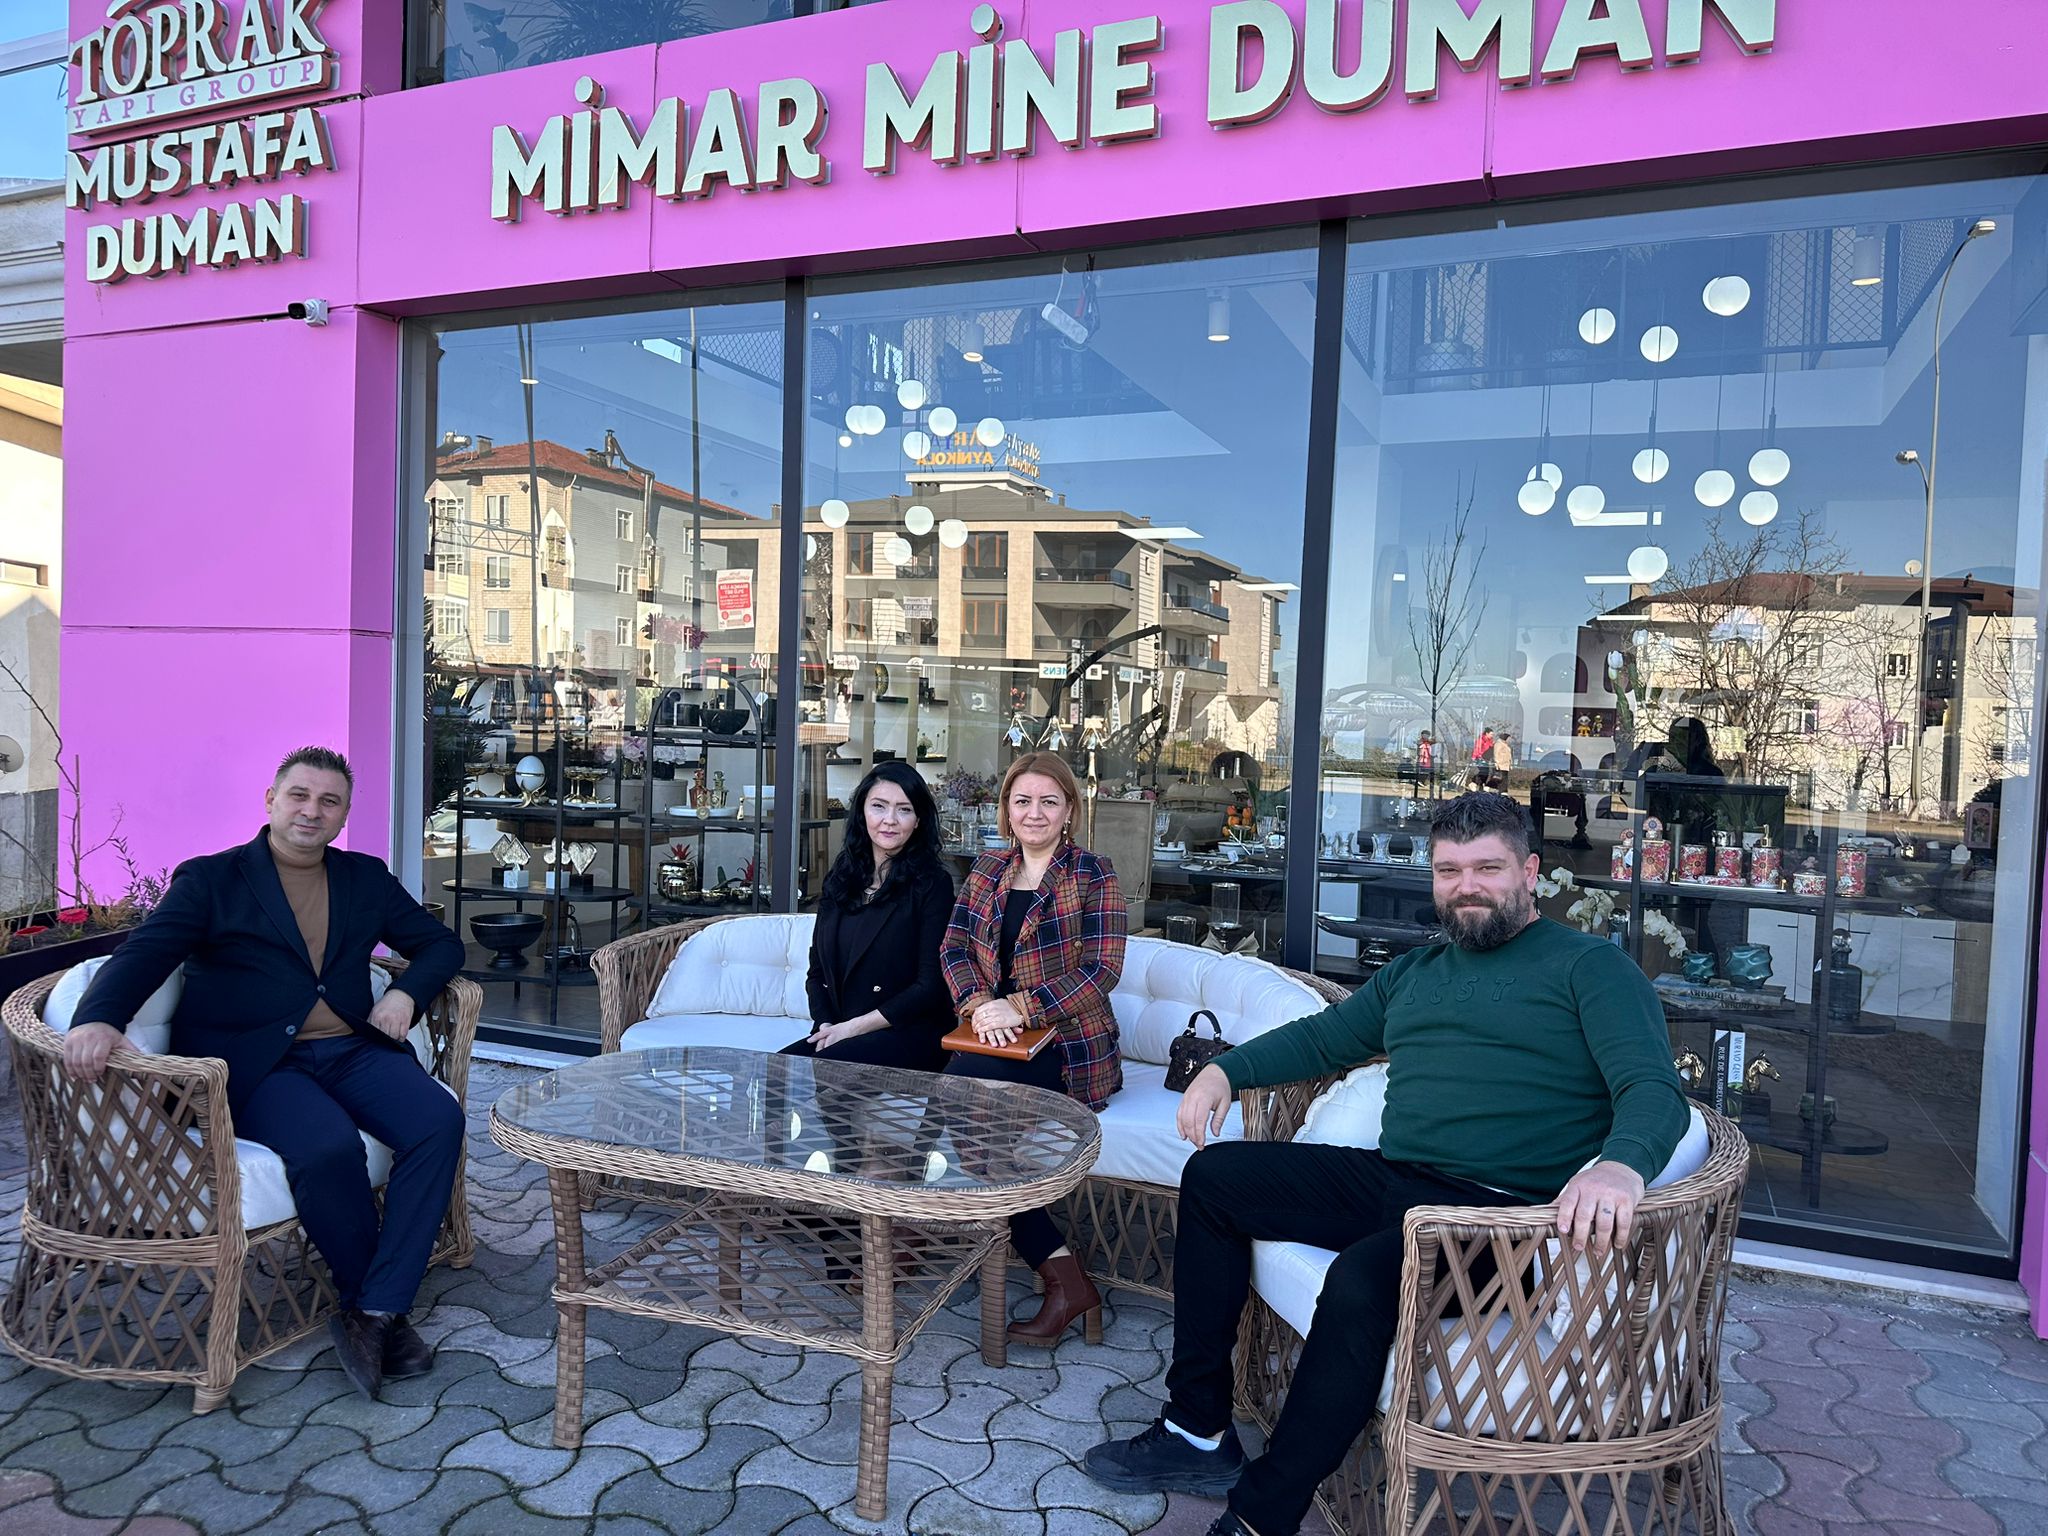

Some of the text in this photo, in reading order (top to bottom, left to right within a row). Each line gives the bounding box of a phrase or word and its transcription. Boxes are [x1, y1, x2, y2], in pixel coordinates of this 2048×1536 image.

[73, 59, 316, 129] YAPI GROUP
[491, 75, 830, 223] MİMAR
[862, 3, 1165, 173] MİNE
[66, 107, 325, 209] MUSTAFA
[87, 193, 301, 282] DUMAN
[1717, 1046, 1726, 1061] RUE
[1717, 1061, 1725, 1071] DE
